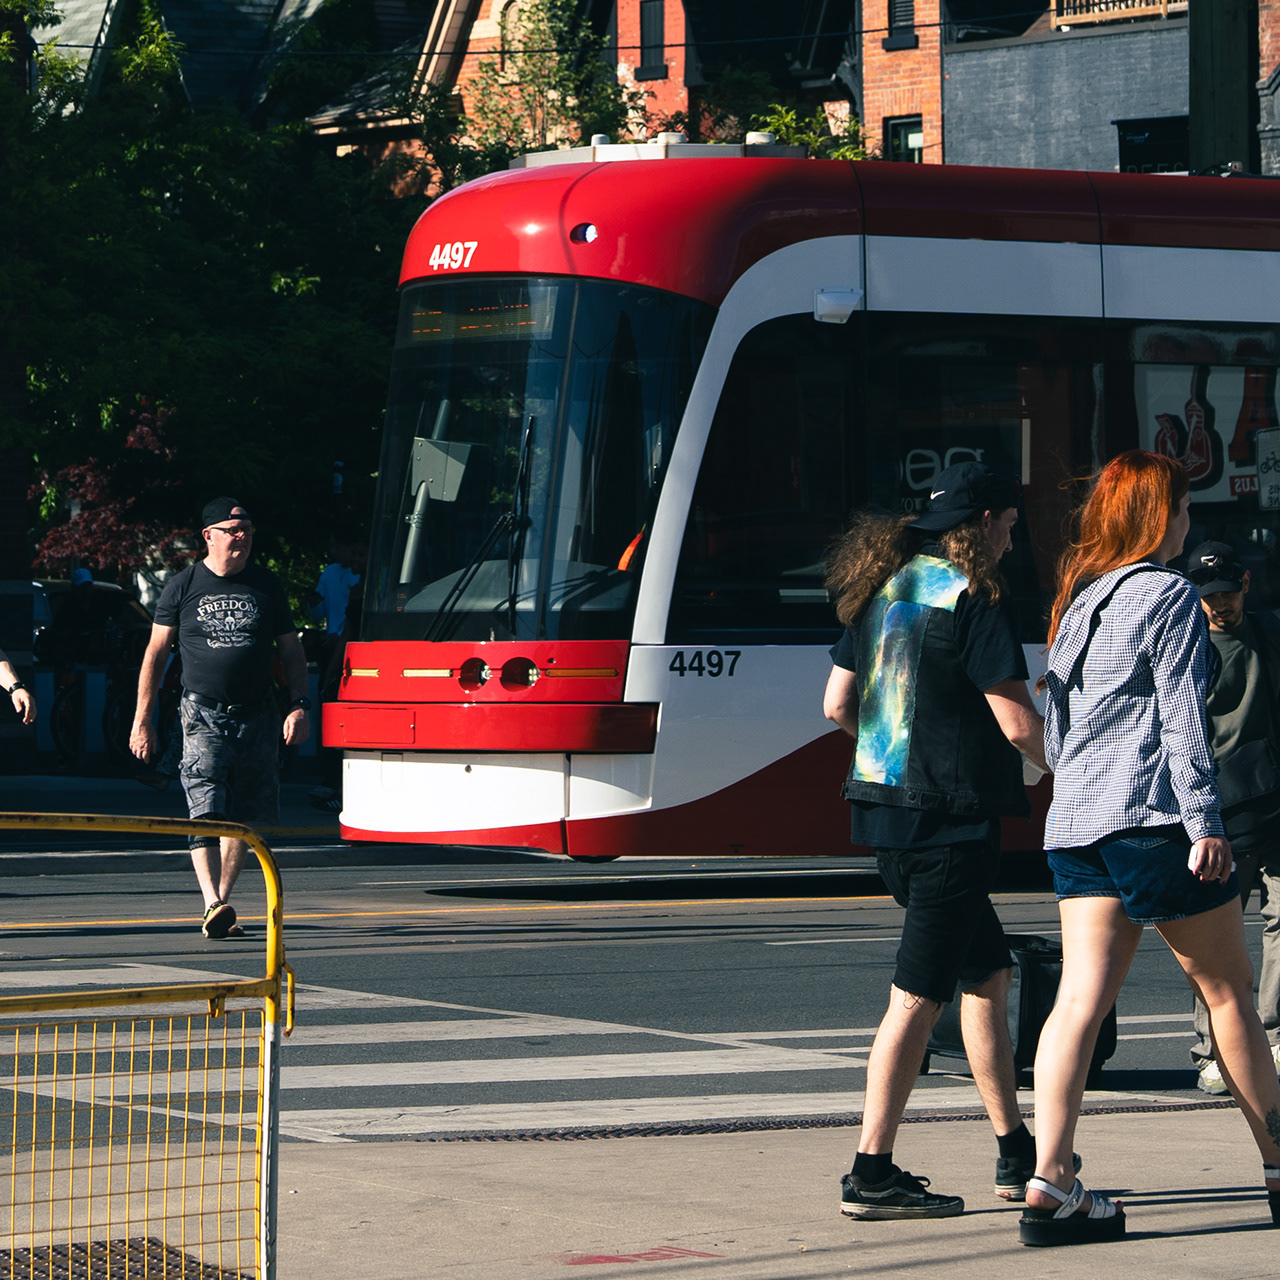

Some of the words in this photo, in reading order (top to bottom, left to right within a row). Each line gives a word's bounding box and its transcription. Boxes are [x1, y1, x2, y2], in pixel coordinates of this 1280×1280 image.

[428, 241, 478, 270] 4497
[197, 599, 259, 617] FREEDOM
[669, 650, 741, 677] 4497
